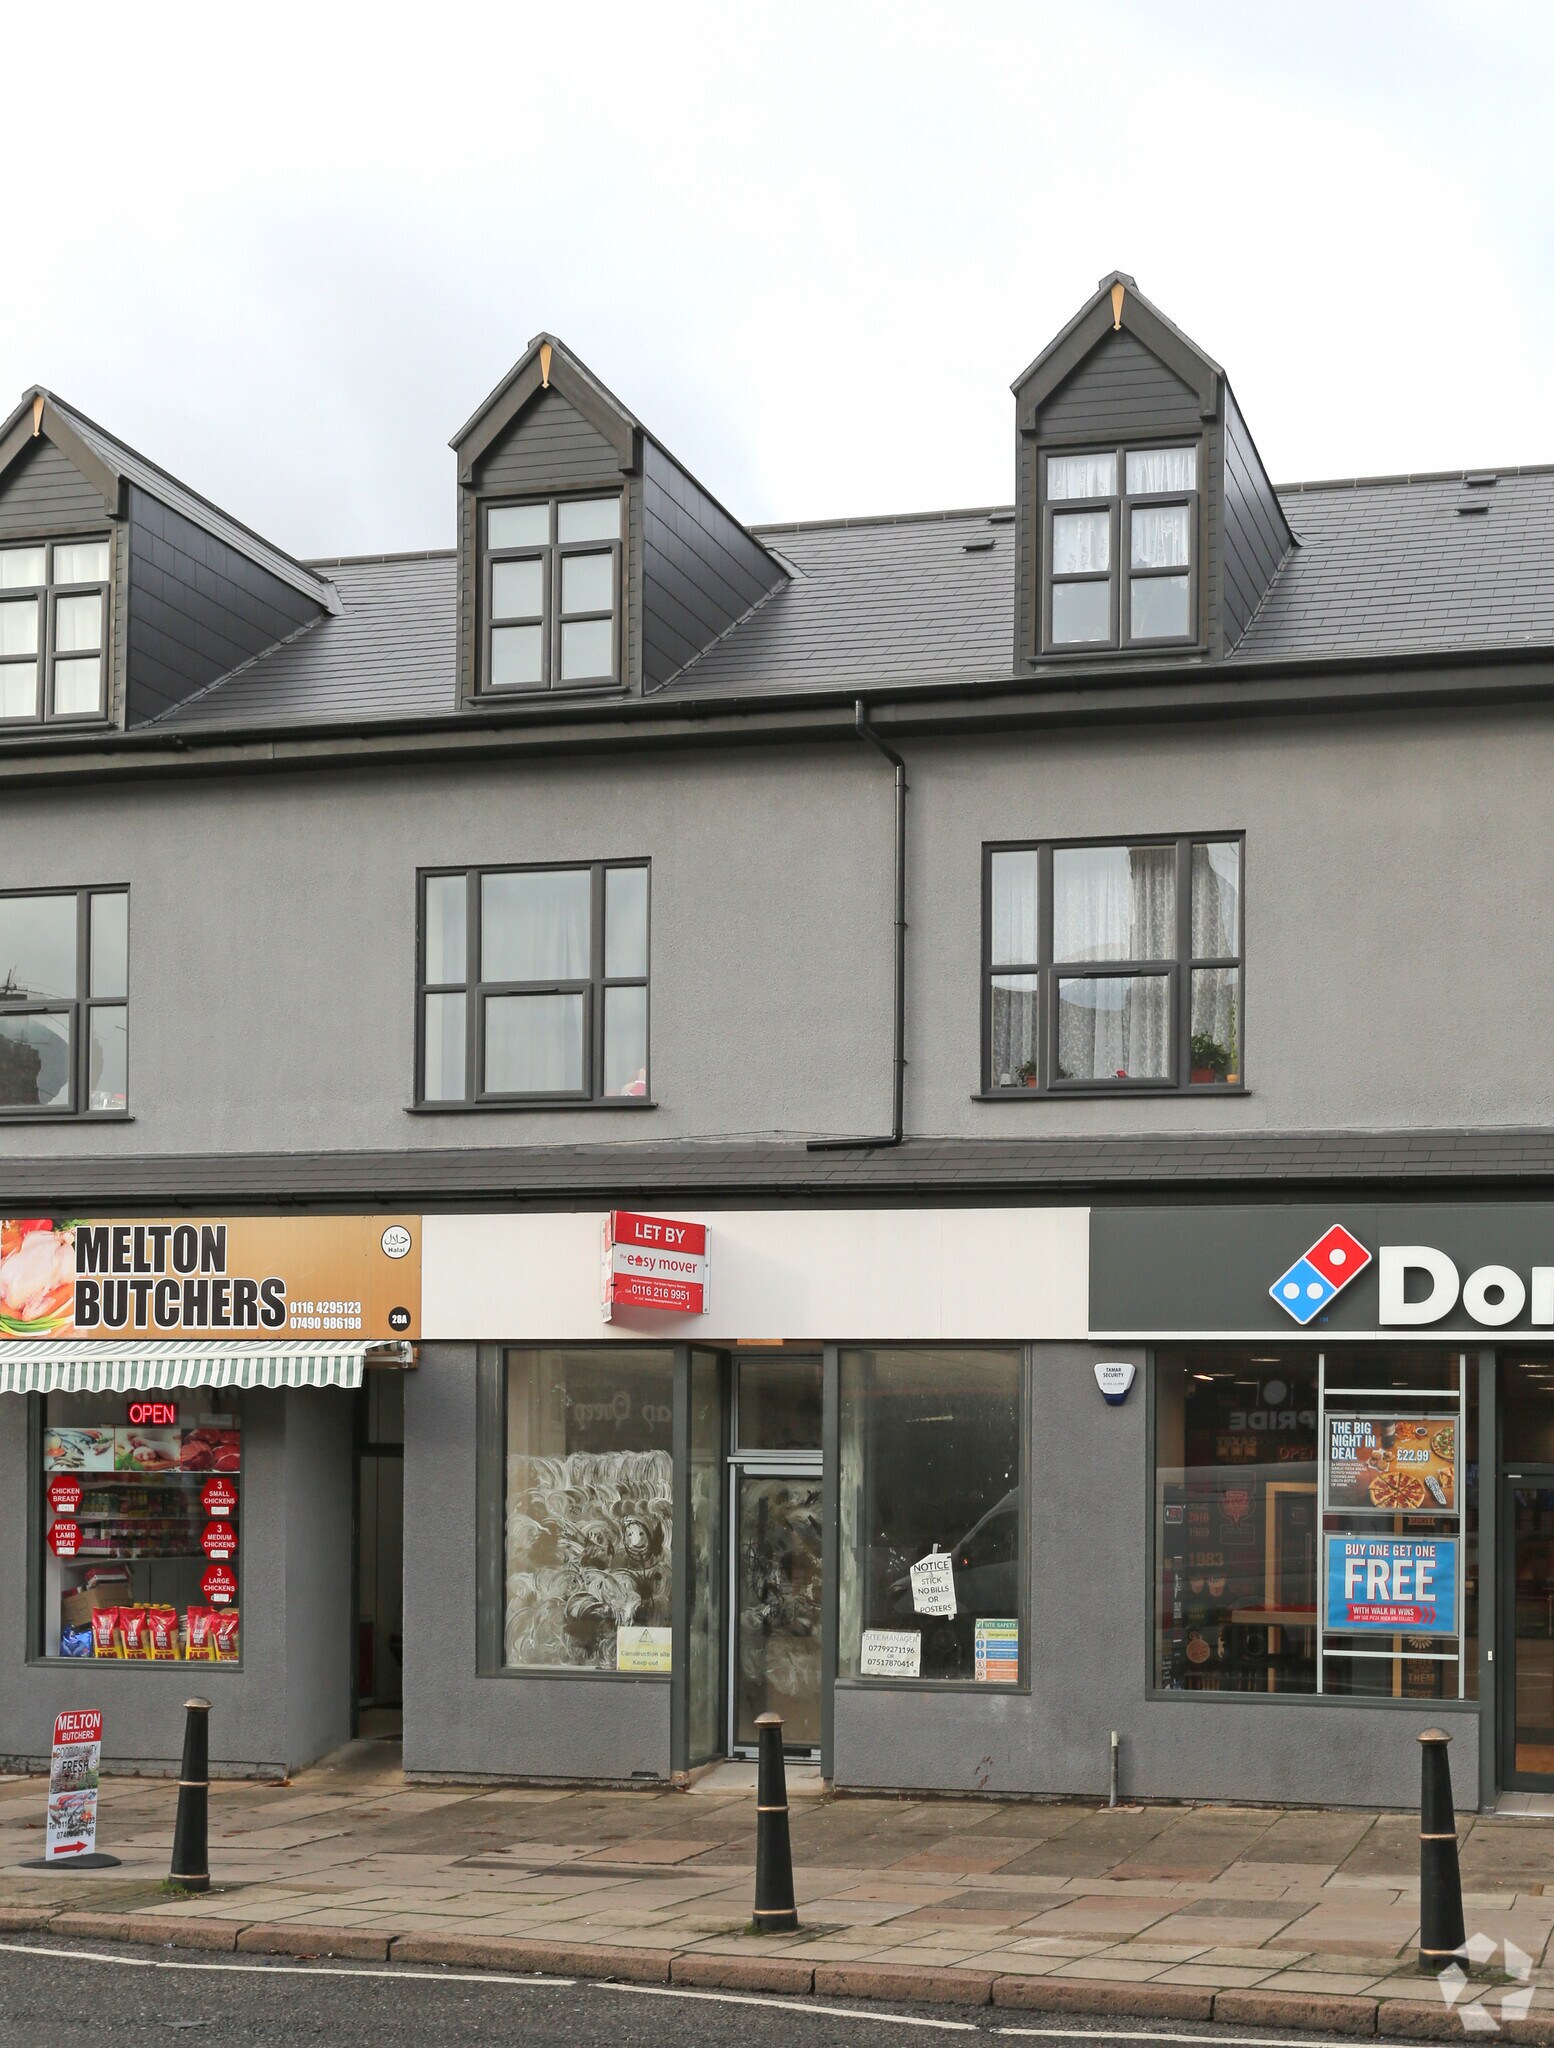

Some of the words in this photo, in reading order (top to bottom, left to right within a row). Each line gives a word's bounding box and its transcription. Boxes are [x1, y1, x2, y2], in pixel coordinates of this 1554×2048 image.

[384, 1233, 408, 1245] حلال
[635, 1222, 661, 1240] LET
[665, 1227, 686, 1244] BY
[74, 1224, 228, 1275] MELTON
[659, 1260, 697, 1273] mover
[632, 1284, 652, 1296] 0116
[654, 1287, 668, 1298] 216
[671, 1289, 690, 1301] 9951
[74, 1277, 287, 1329] BUTCHERS
[290, 1302, 314, 1314] 0116
[316, 1301, 361, 1314] 4295123
[290, 1316, 322, 1329] 07490
[323, 1316, 361, 1329] 986198
[392, 1313, 407, 1324] 28A
[129, 1404, 175, 1424] OPEN
[1331, 1422, 1353, 1434] THE
[1354, 1422, 1371, 1435] BIG
[1216, 1436, 1257, 1447] TEXAS
[1331, 1435, 1363, 1447] NIGHT
[1365, 1435, 1376, 1447] IN
[1279, 1447, 1313, 1460] OPE
[1331, 1448, 1357, 1460] DEAL
[51, 1487, 80, 1495] CHICKEN
[217, 1481, 222, 1490] 3
[217, 1524, 222, 1533] 3
[56, 1539, 75, 1547] MEAT
[1346, 1544, 1366, 1555] BUY
[1369, 1545, 1389, 1556] ONE
[1393, 1545, 1412, 1556] GET
[1415, 1546, 1435, 1557] ONE
[1188, 1552, 1224, 1567] 1983
[913, 1560, 949, 1572] NOTICE
[217, 1568, 222, 1577] 3
[921, 1577, 942, 1585] STICK
[1345, 1558, 1436, 1601] FREE
[931, 1585, 949, 1593] BILLS
[920, 1605, 952, 1613] POSTERS
[1353, 1606, 1369, 1614] WITH
[1371, 1607, 1388, 1615] WALK
[1398, 1608, 1414, 1616] WINS
[882, 1635, 917, 1643] MANAGER
[868, 1645, 915, 1654] 07799271196
[867, 1659, 914, 1667] 07517870414
[1408, 1673, 1434, 1682] THEM
[57, 1713, 100, 1731] MELTON
[62, 1730, 94, 1741] BUTCHERS
[61, 1760, 90, 1774] FRESH
